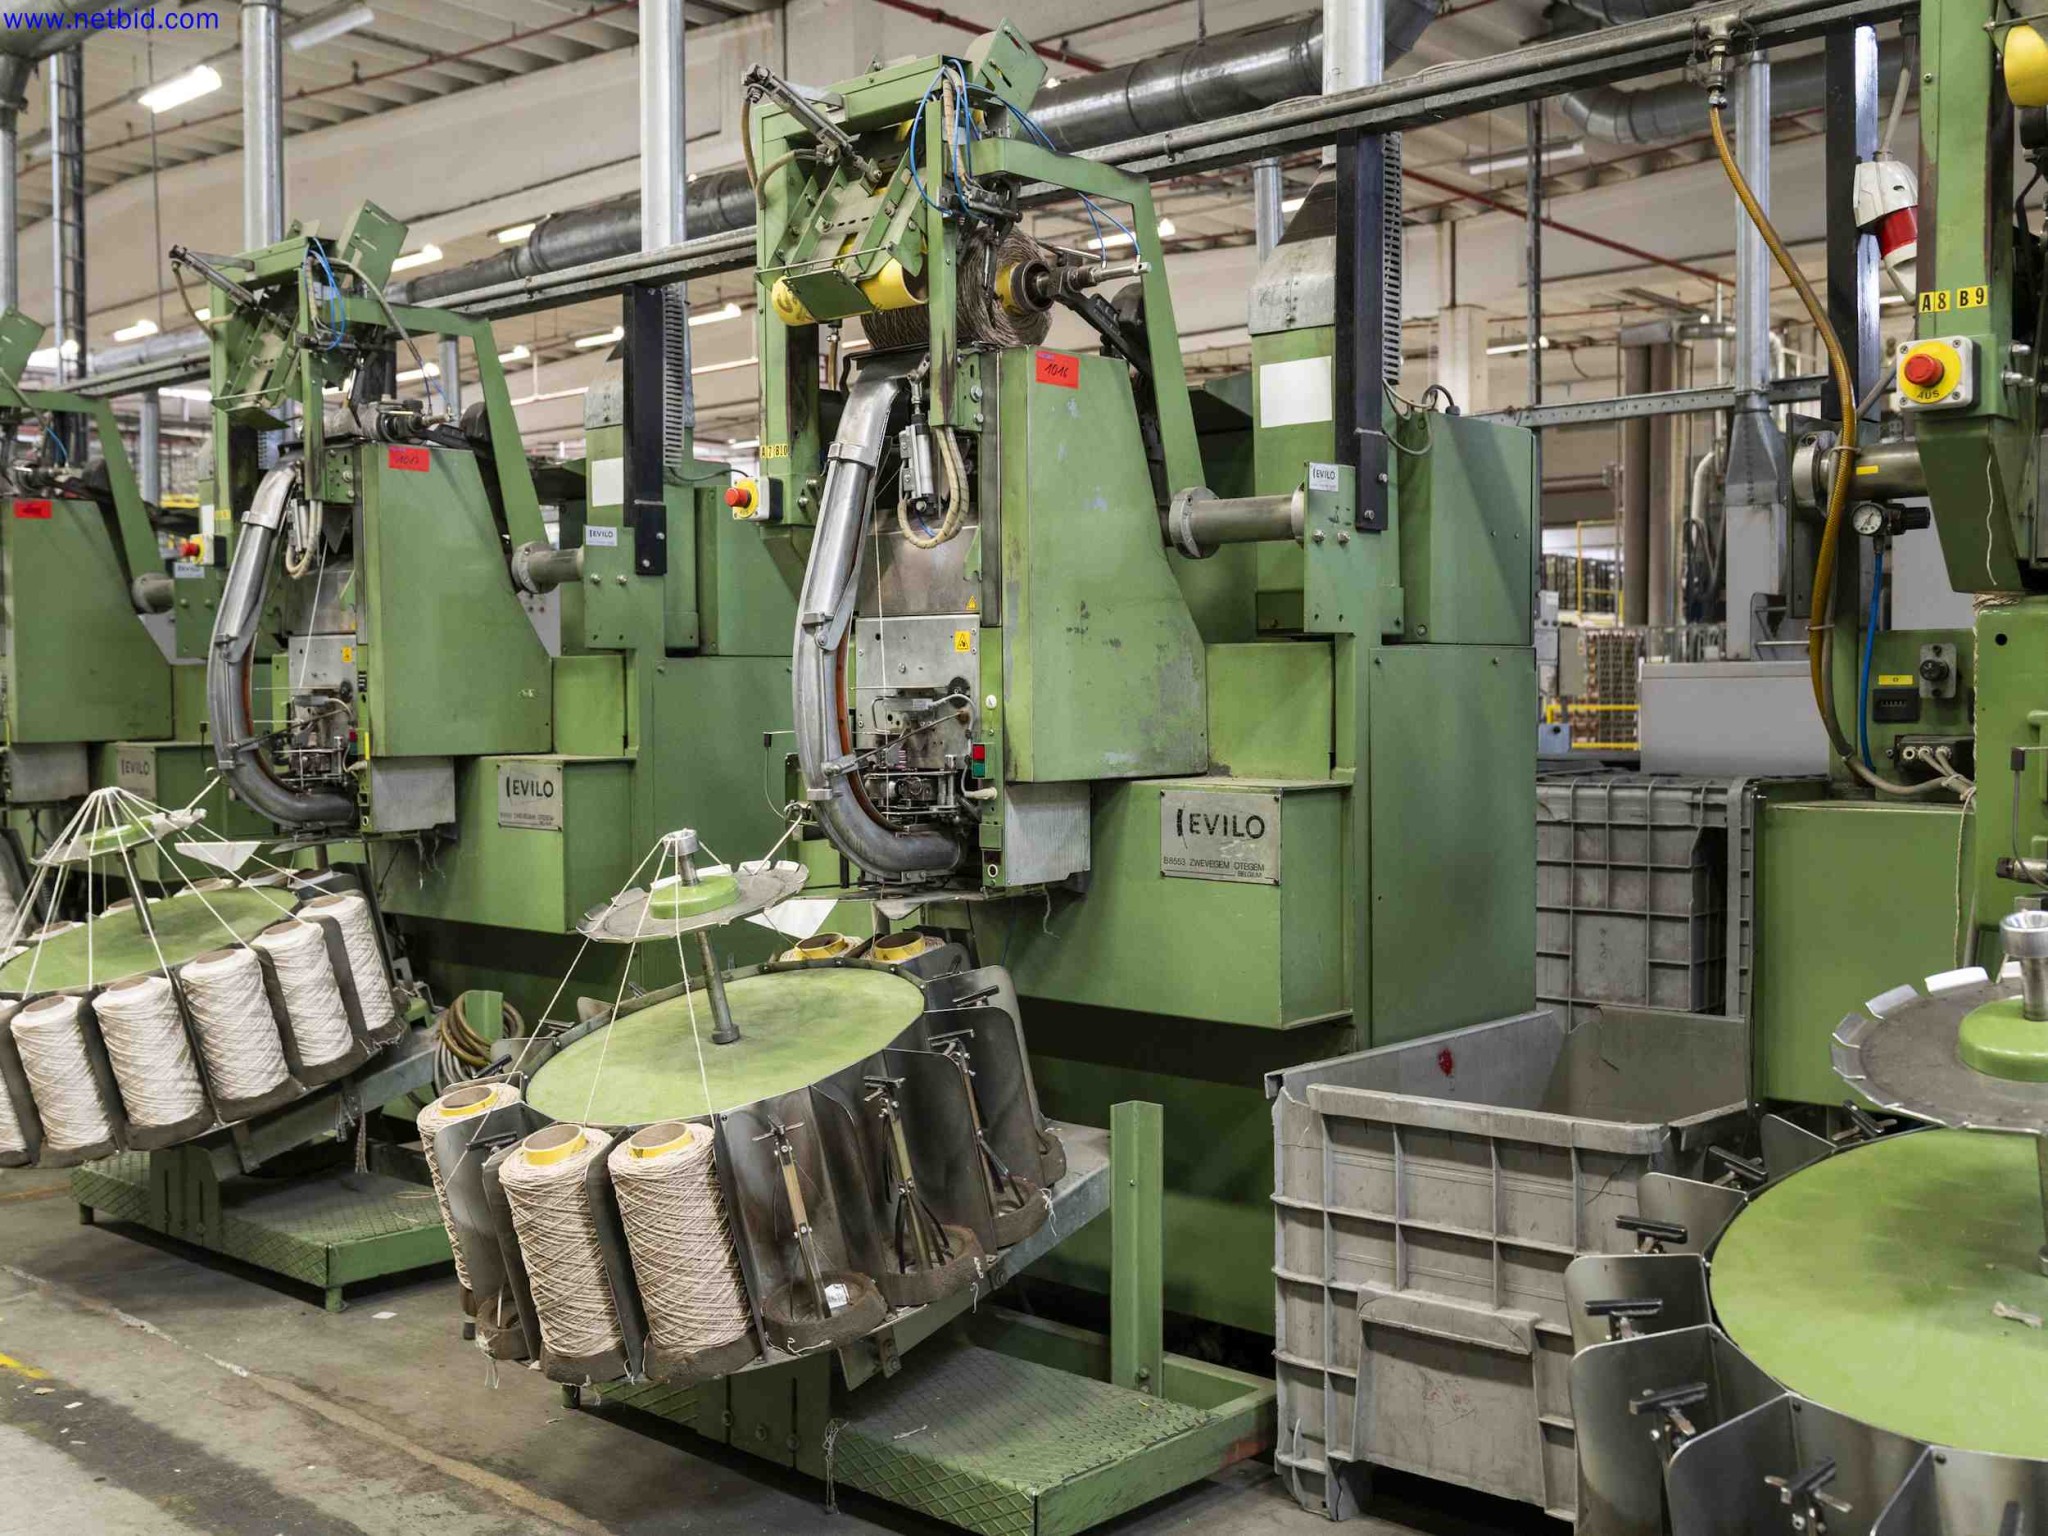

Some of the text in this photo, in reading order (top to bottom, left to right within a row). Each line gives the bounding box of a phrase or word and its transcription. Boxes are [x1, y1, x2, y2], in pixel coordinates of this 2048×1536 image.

[1922, 287, 1985, 312] A8 B9
[1916, 389, 1940, 400] AUS
